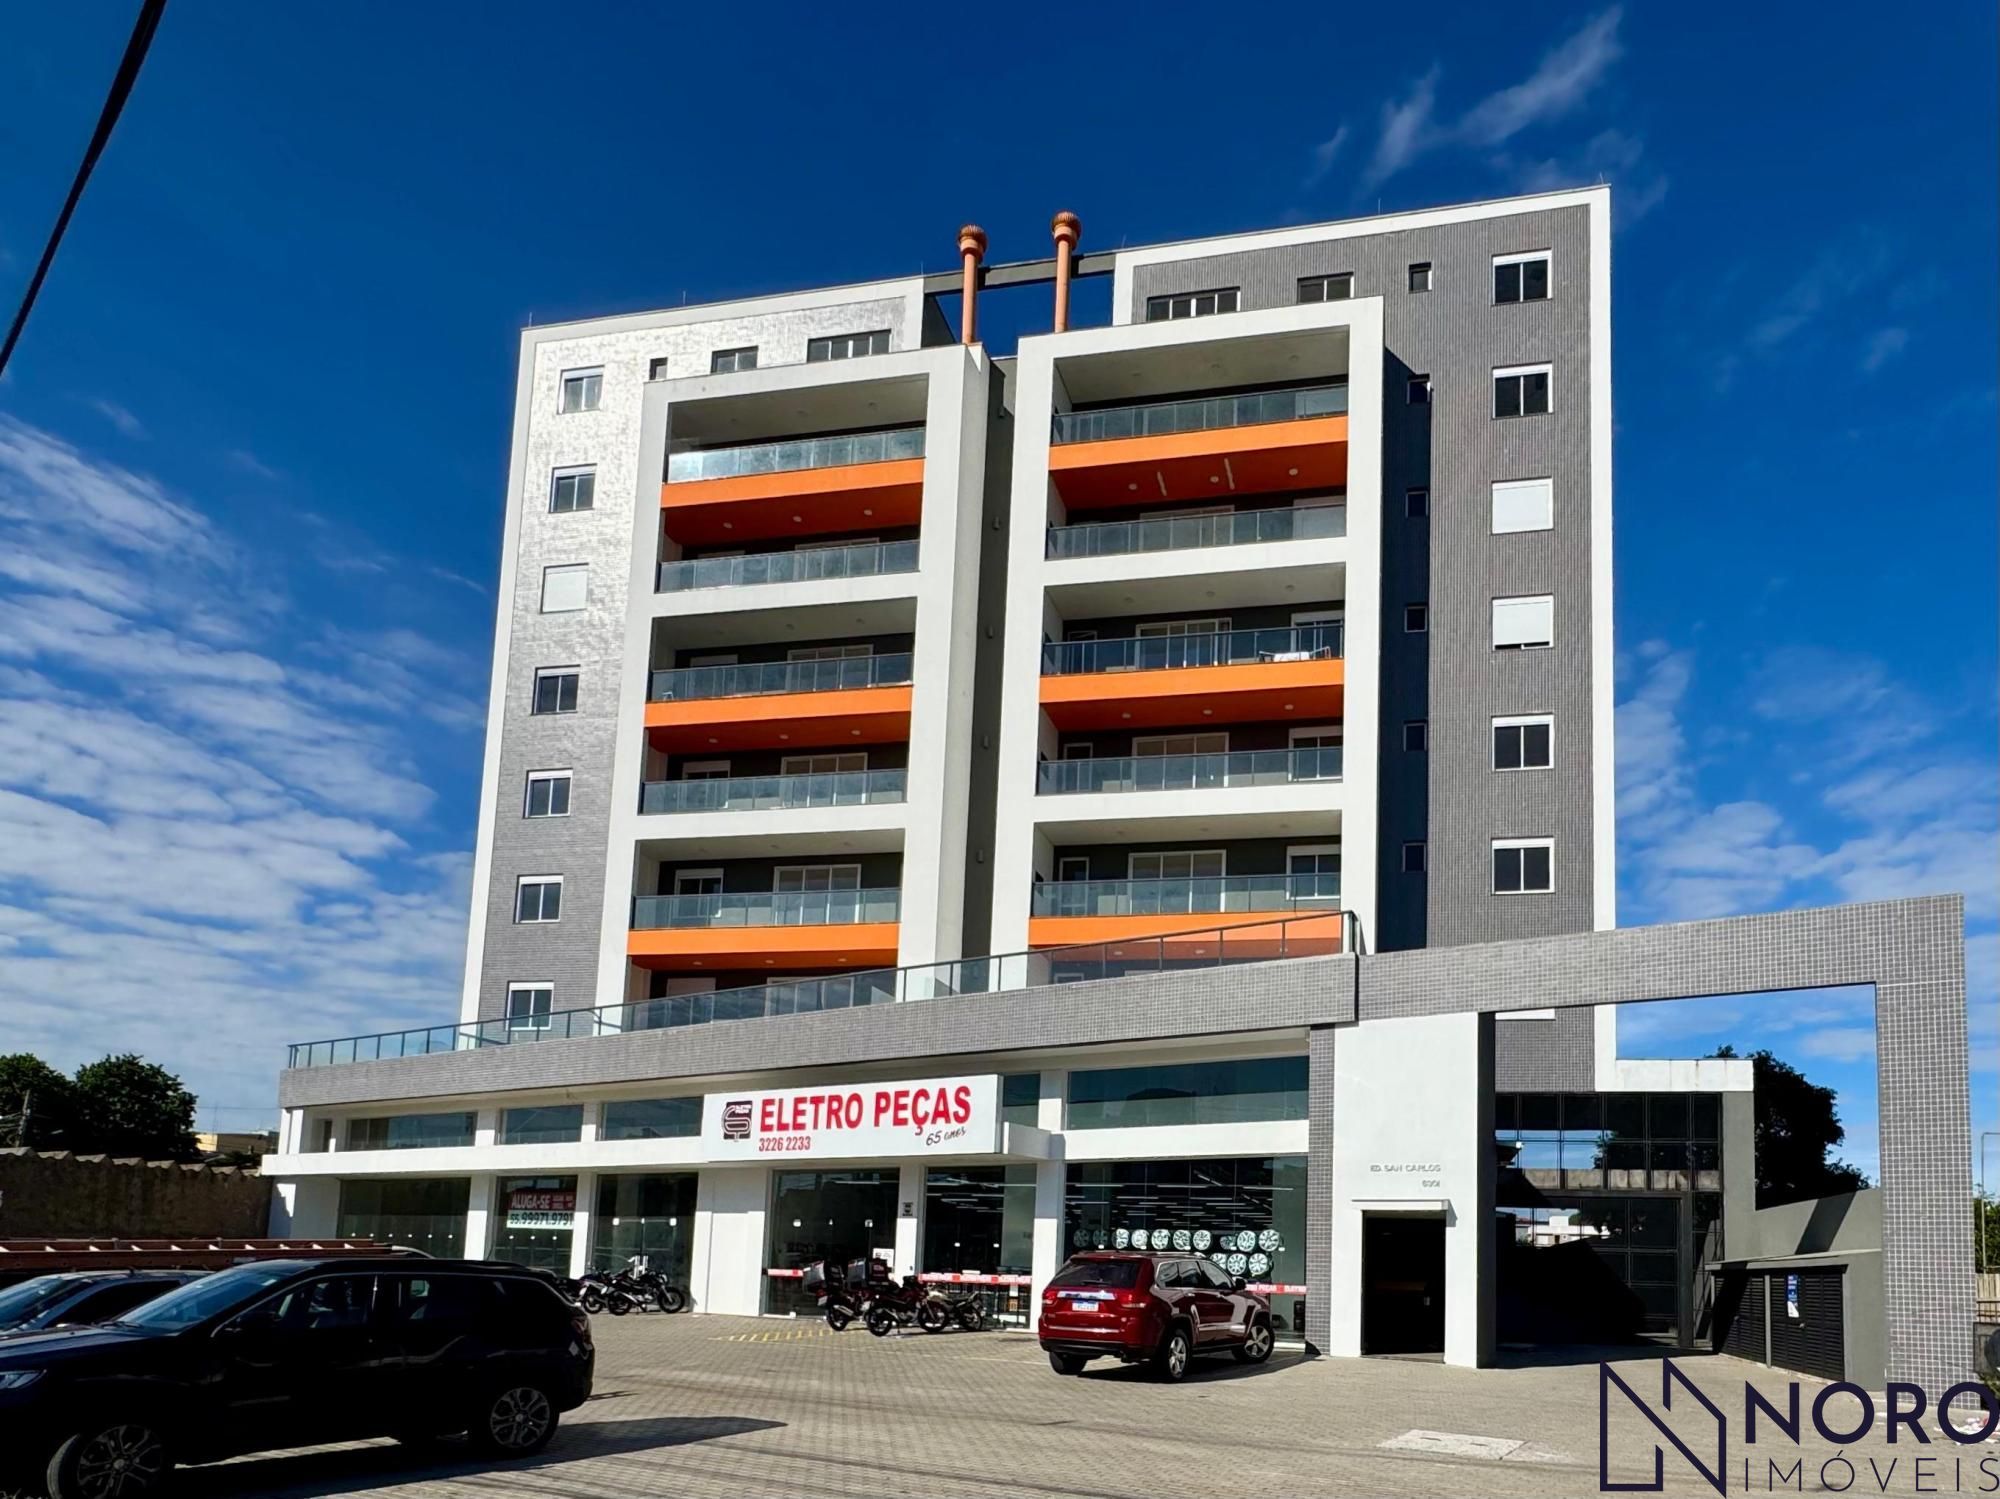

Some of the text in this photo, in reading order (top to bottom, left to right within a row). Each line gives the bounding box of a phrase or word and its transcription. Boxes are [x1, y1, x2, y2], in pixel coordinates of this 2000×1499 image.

[760, 1086, 971, 1136] ELETRO PEÇAS
[758, 1136, 811, 1152] 3226 2233
[926, 1130, 942, 1146] 65
[1405, 1164, 1441, 1172] CARLOS
[511, 1194, 551, 1209] ALUGA-SE
